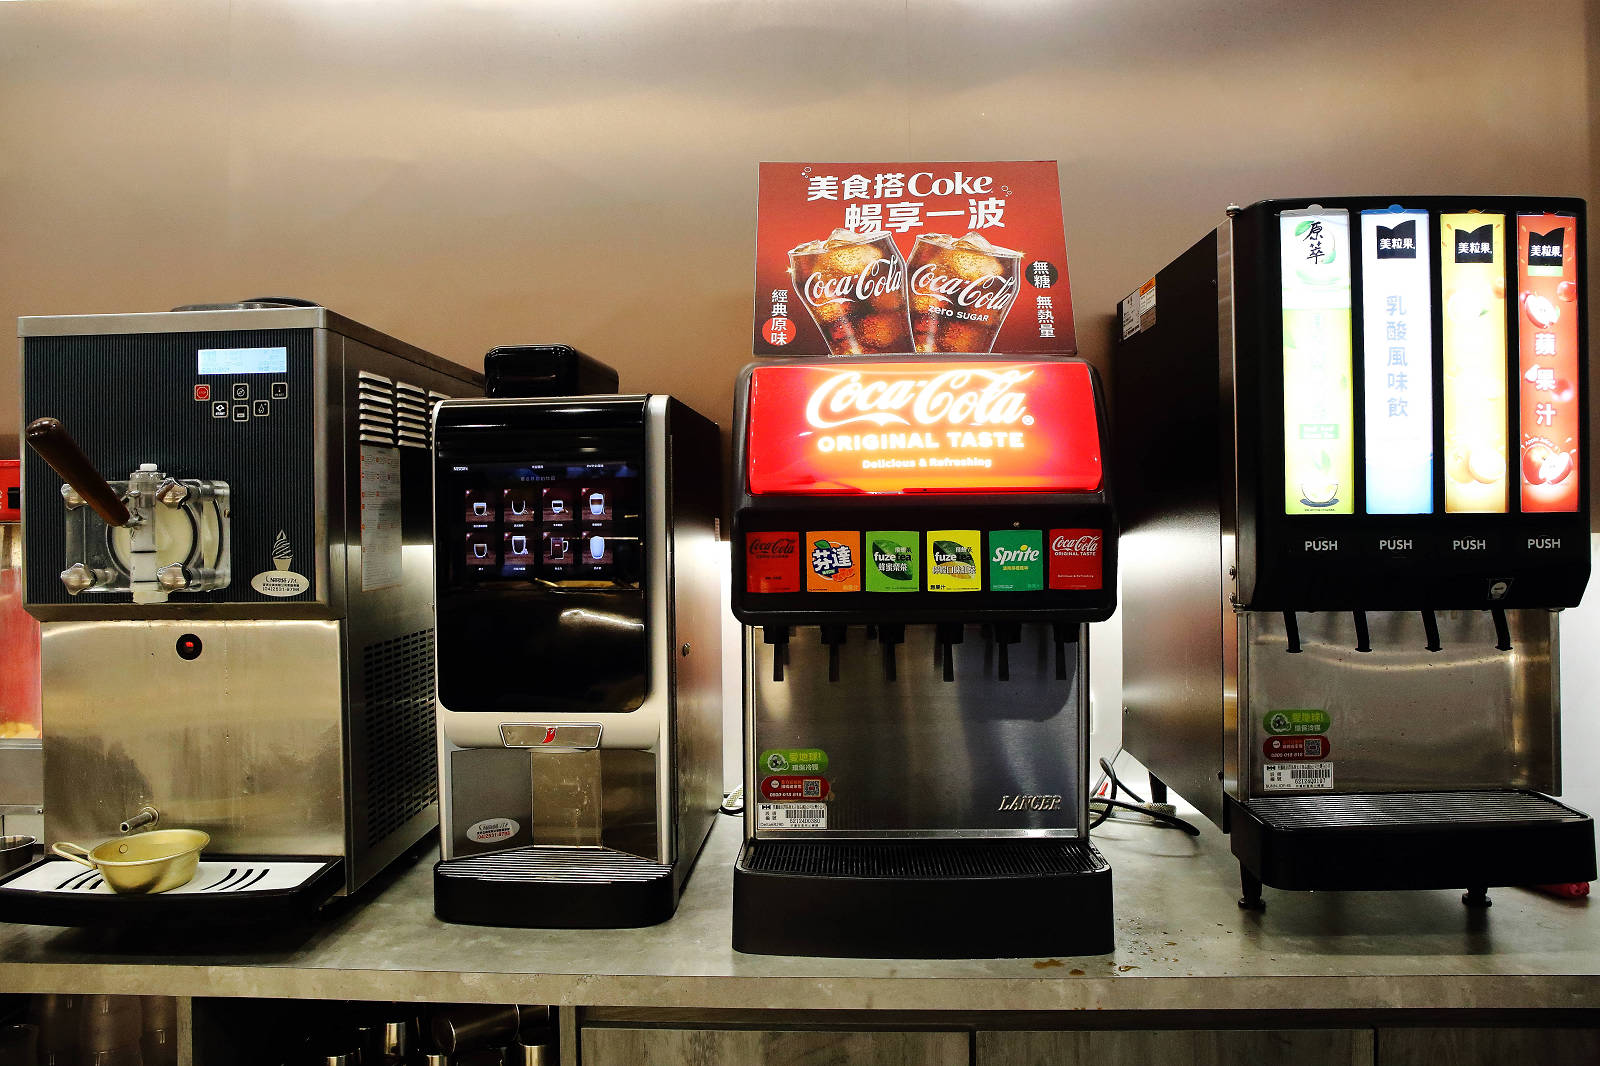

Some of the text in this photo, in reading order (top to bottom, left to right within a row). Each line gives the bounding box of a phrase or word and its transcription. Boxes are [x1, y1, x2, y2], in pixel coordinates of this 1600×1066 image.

[844, 197, 1006, 234] 暢享一波
[1379, 237, 1415, 251] 美粒果
[1457, 241, 1492, 255] 美粒果
[1530, 244, 1562, 258] 美粒果
[804, 254, 903, 307] Coca-Cola
[1032, 260, 1051, 288] 無糖
[910, 262, 1015, 311] Coca-Cola
[770, 289, 788, 345] 經典原味
[956, 310, 989, 322] SUGAR
[1035, 295, 1056, 338] 無熱量
[1385, 294, 1409, 419] 乳酸風味飲
[1534, 332, 1557, 427] 蘋果汁
[805, 369, 1035, 428] Coca-Cola
[817, 431, 1025, 452] ORIGINAL TASTE
[862, 457, 992, 469] Delicious & Refreshing
[749, 538, 796, 555] Coca-Cola
[1052, 535, 1101, 552] Coca-Cola
[1304, 539, 1338, 551] PUSH
[1379, 539, 1413, 551] PUSH
[1452, 539, 1486, 551] PUSH
[1527, 538, 1561, 549] PUSH
[812, 545, 852, 572] 芬達
[992, 545, 1040, 565] Sprite
[998, 794, 1062, 811] LANCER
